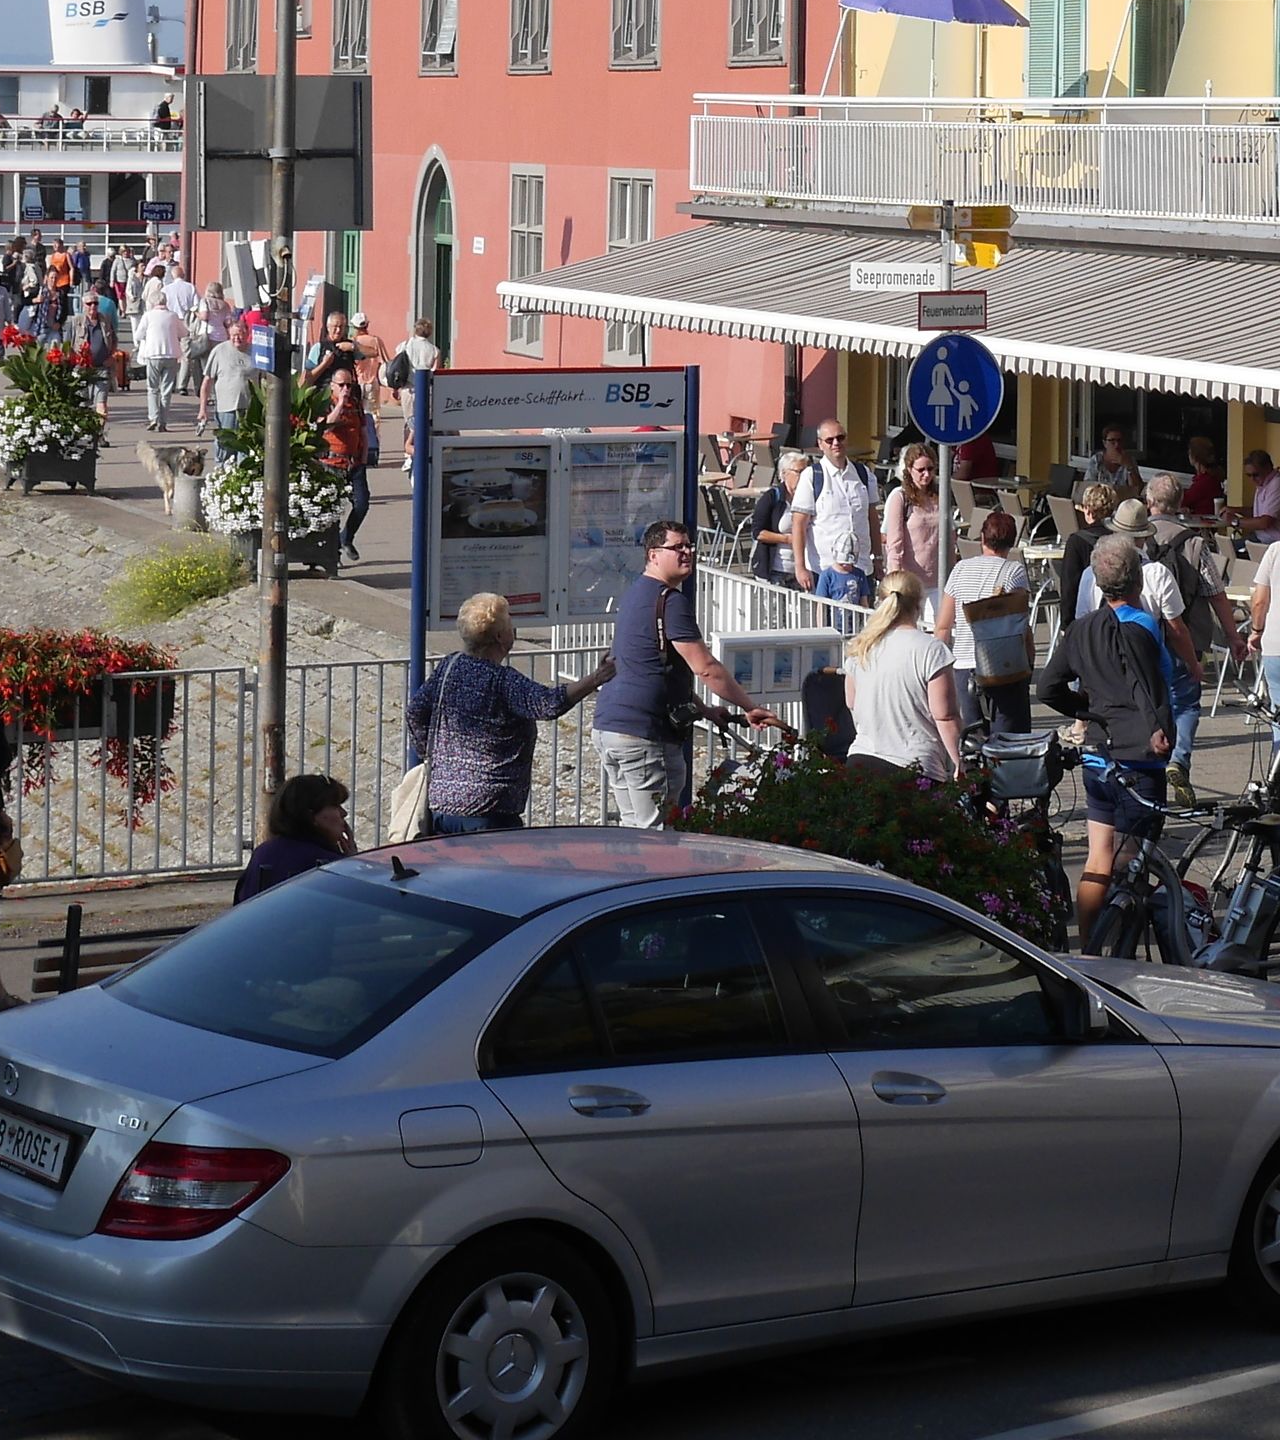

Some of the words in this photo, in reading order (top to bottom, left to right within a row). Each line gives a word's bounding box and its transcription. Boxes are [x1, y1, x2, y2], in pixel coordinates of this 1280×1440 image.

[65, 0, 105, 17] BSB
[143, 203, 173, 212] Eingang
[856, 269, 935, 289] Seepromenade
[923, 305, 983, 318] Feuerwehrzufahrt
[605, 383, 651, 403] BSB
[445, 397, 463, 408] Die
[118, 1114, 149, 1131] CDI
[12, 1126, 52, 1168] ROSE
[51, 1142, 61, 1172] 1
